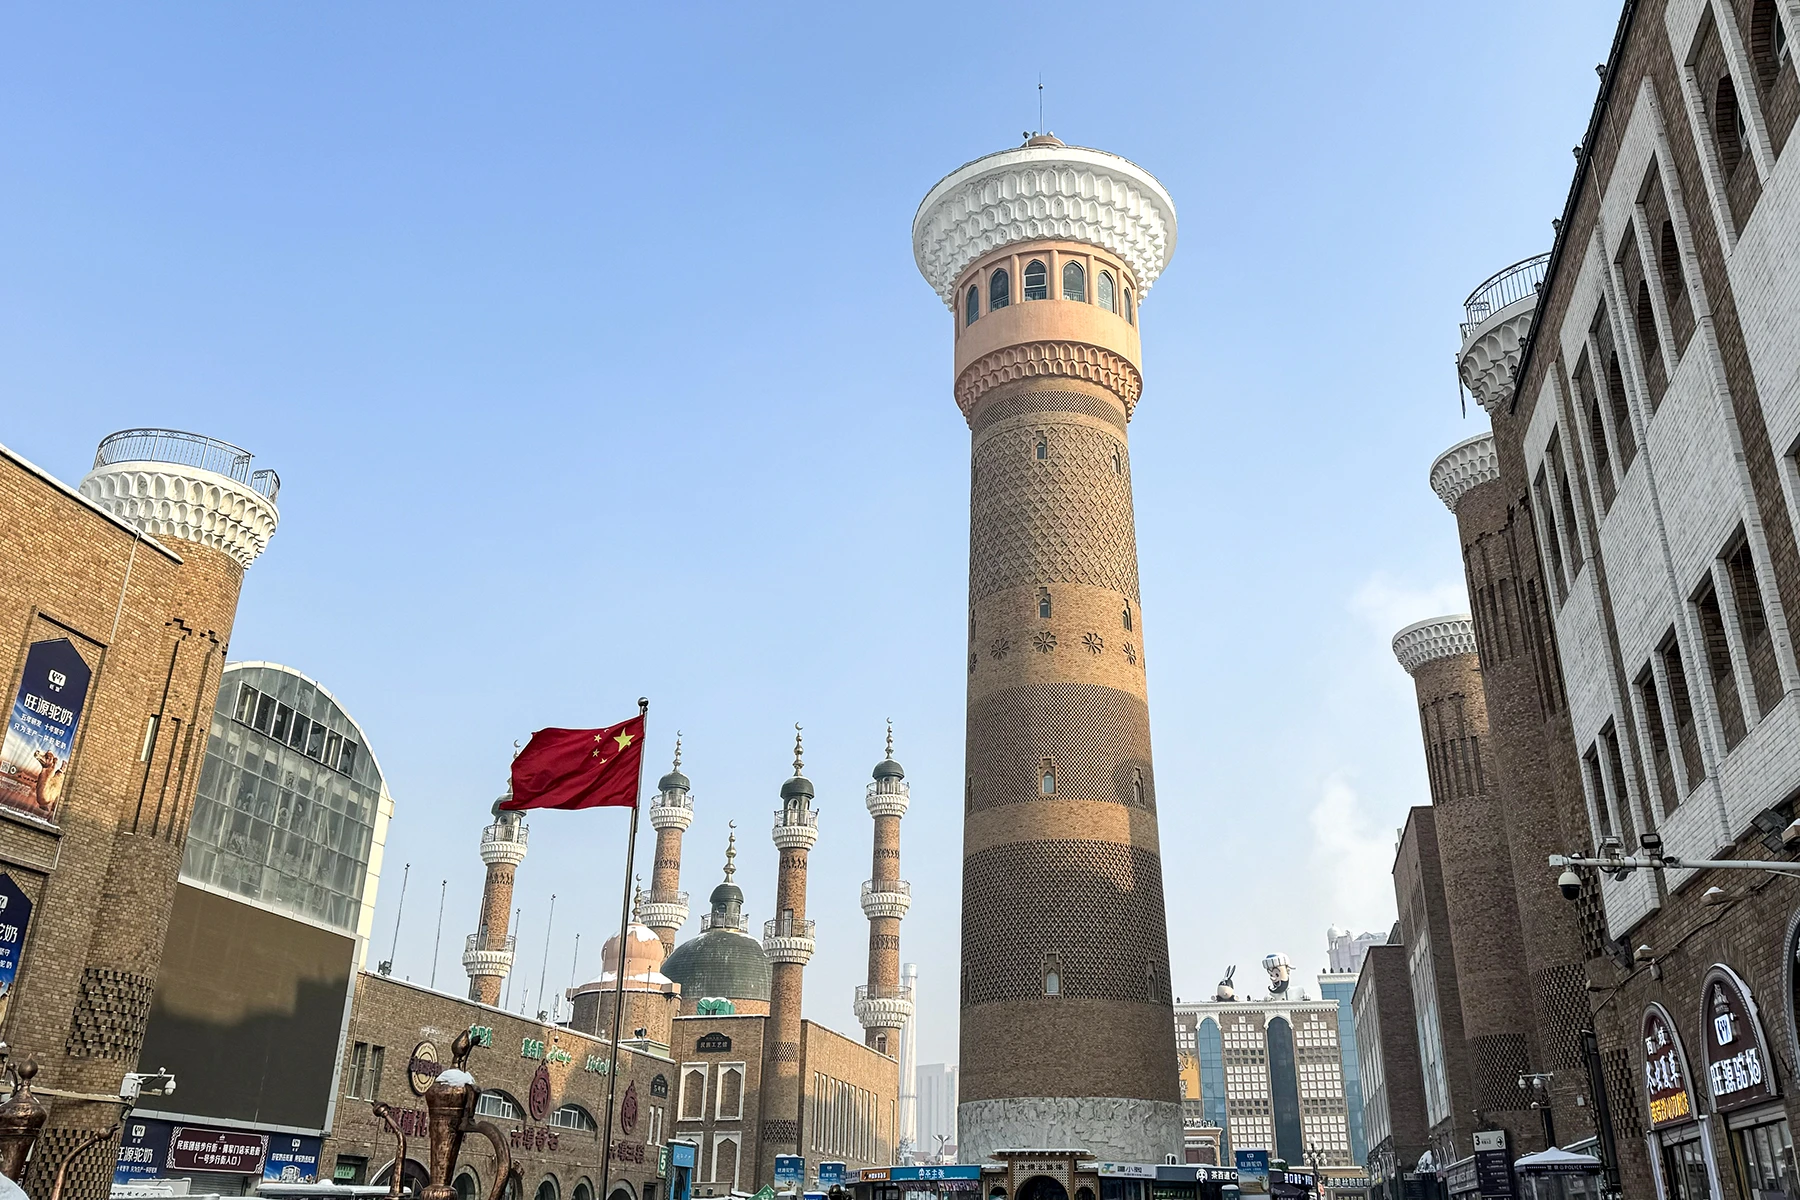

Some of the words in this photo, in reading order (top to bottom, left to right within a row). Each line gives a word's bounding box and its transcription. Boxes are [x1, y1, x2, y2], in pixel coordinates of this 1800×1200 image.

[24, 692, 73, 727] 旺源驼奶
[1646, 1050, 1681, 1095] 冬虫夏草
[1710, 1048, 1762, 1096] 旺源驼奶
[1474, 1135, 1481, 1146] 3
[660, 1154, 667, 1170] 5
